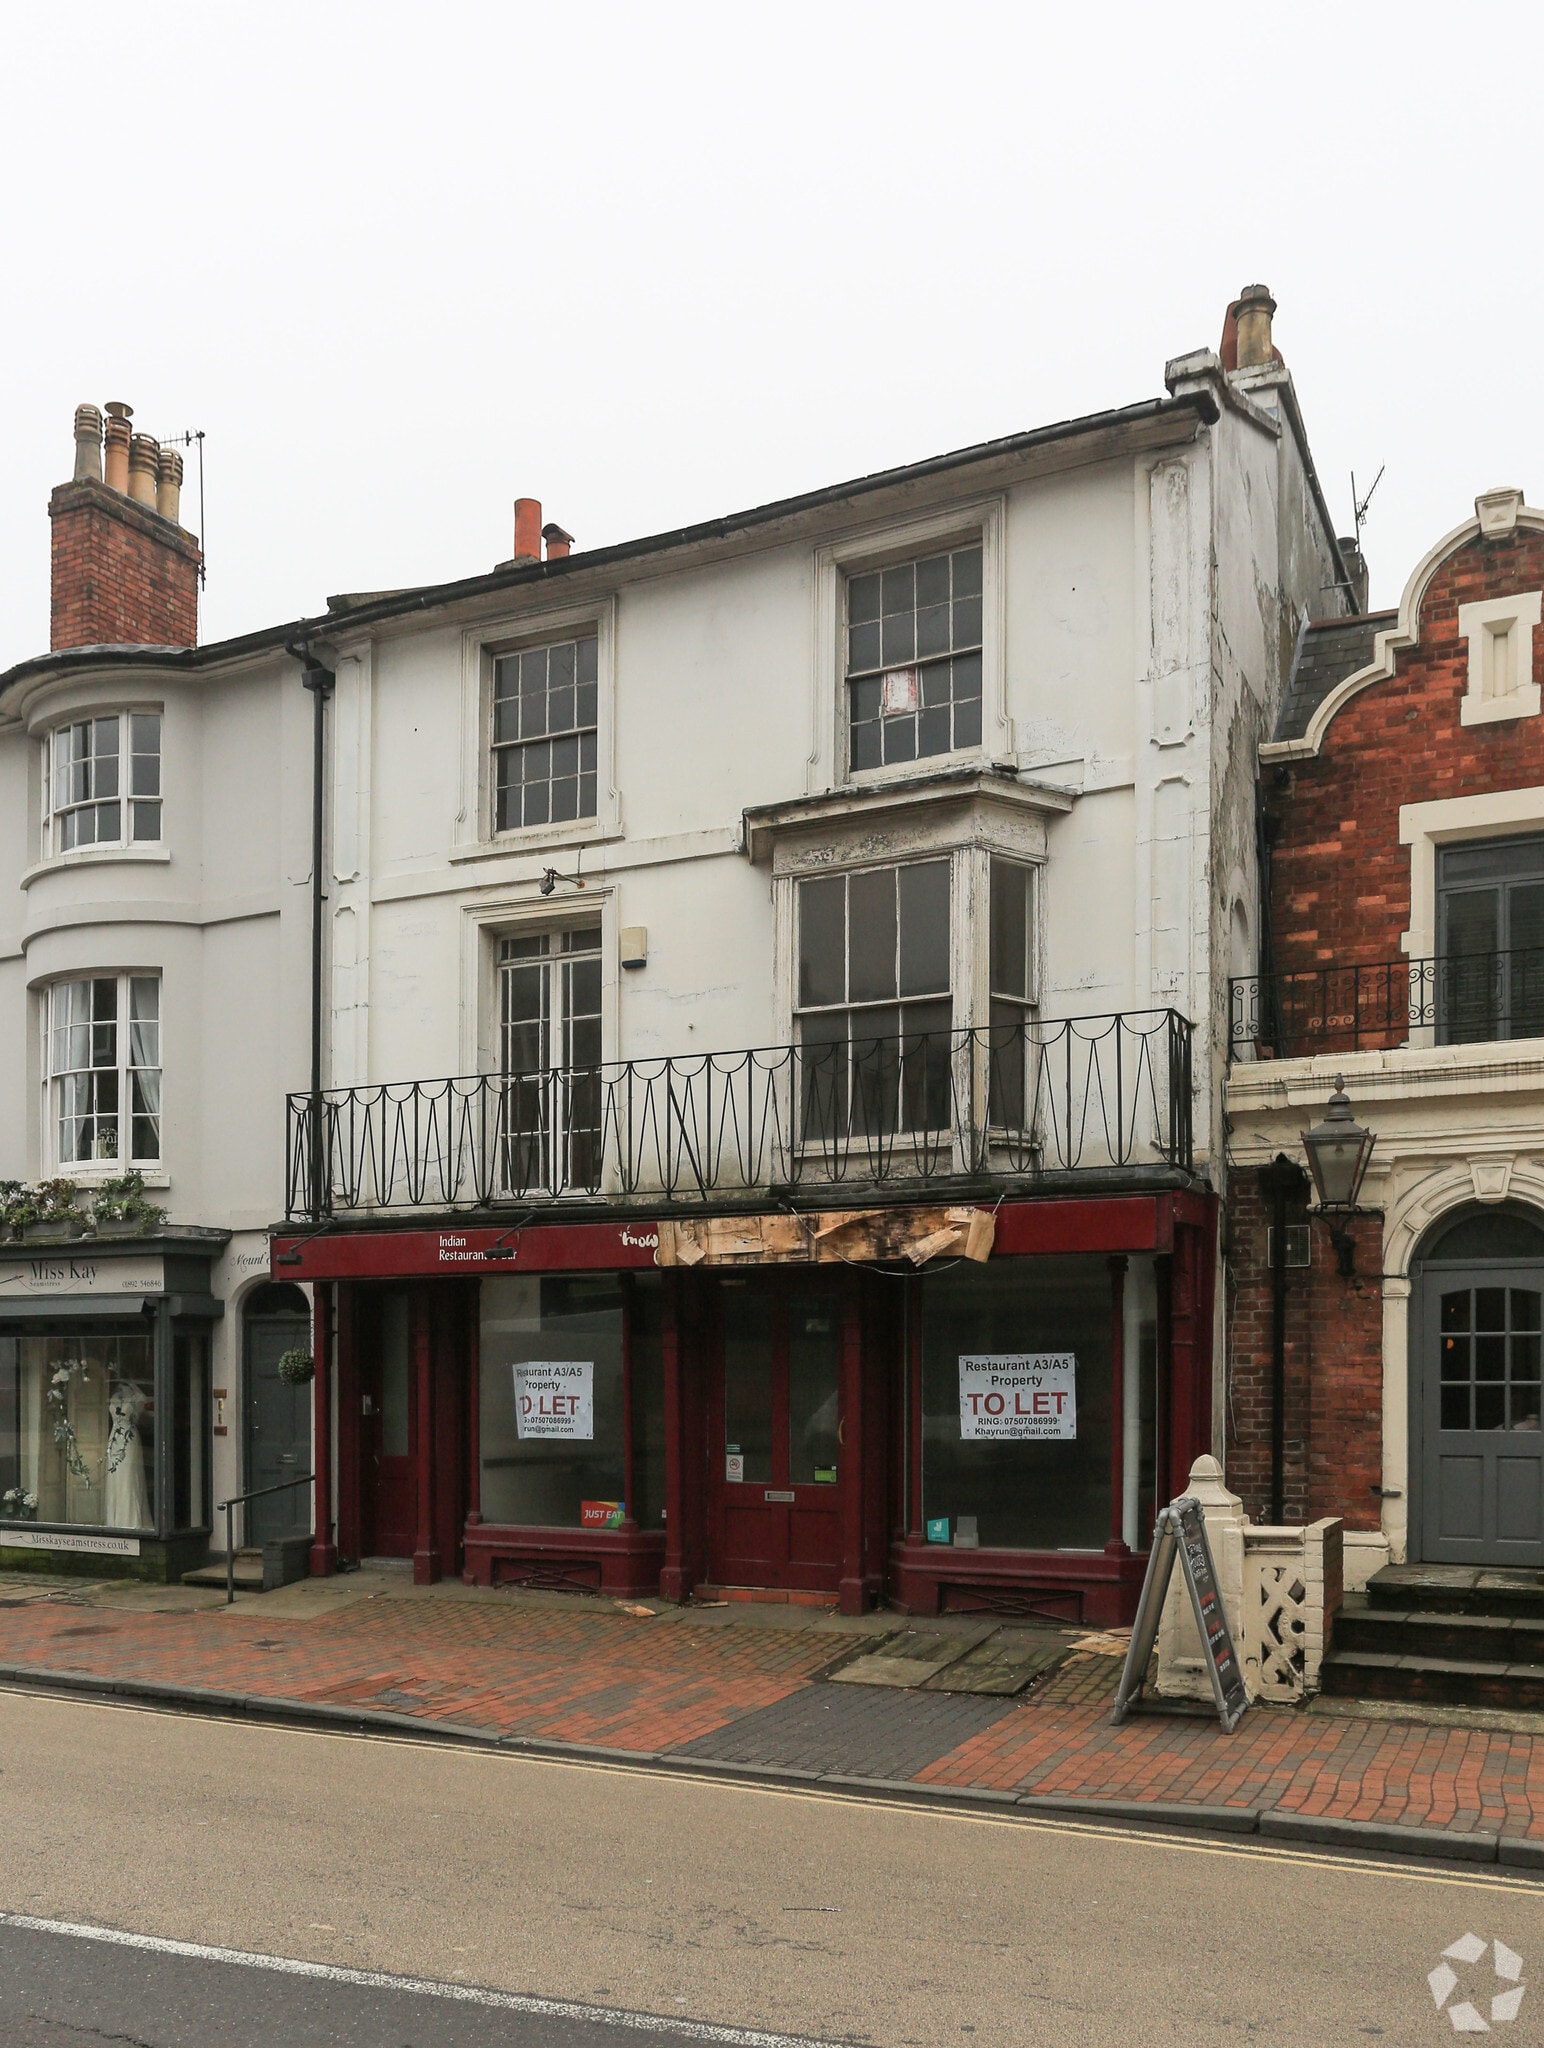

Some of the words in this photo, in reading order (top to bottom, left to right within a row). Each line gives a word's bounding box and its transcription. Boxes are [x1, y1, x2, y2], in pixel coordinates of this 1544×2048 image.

[439, 1235, 466, 1247] Indian
[439, 1249, 487, 1260] Restauran
[30, 1261, 64, 1280] Miss
[69, 1260, 99, 1285] Kay
[966, 1360, 1030, 1371] Restaurant
[1033, 1359, 1069, 1370] A3/A5
[554, 1367, 583, 1377] A3/A5
[991, 1375, 1043, 1387] Property
[539, 1395, 580, 1415] LET
[967, 1392, 1005, 1415] TO
[1015, 1392, 1068, 1415] LET
[978, 1417, 1003, 1425] RING:
[1004, 1417, 1058, 1425] 07507086999
[975, 1427, 1061, 1436] Khayrun@gmail.com
[584, 1510, 604, 1519] JUST
[606, 1510, 622, 1519] EAT
